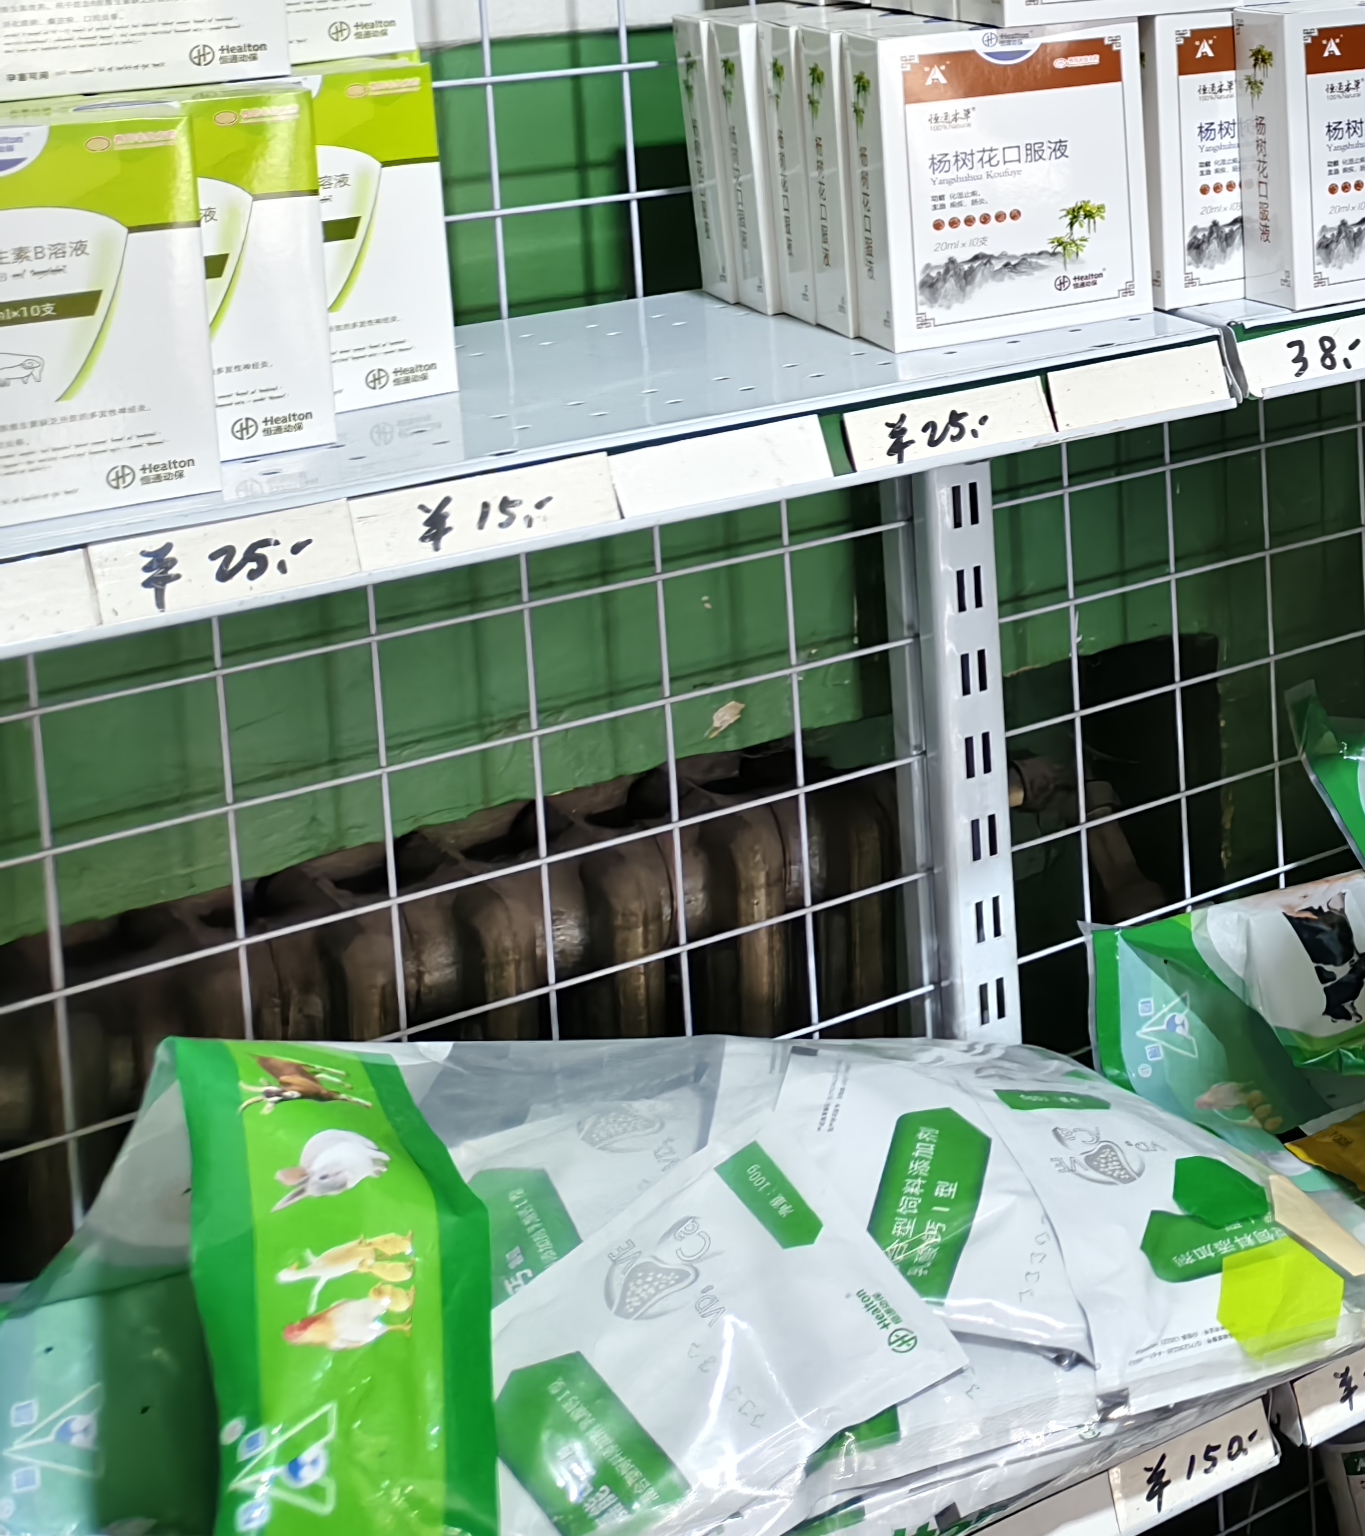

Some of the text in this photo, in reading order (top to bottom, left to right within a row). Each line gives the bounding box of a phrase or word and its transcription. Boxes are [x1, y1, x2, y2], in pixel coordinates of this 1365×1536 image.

[354, 19, 396, 30] Healton
[218, 43, 267, 55] Healton
[929, 139, 1069, 176] 杨树花口服液
[986, 169, 1022, 180] Koufuye
[1254, 115, 1271, 244] 杨树花口服液
[1073, 272, 1103, 282] Healton
[392, 362, 437, 377] Healton
[262, 410, 313, 426] Healton
[263, 422, 303, 437] 恒通动保
[140, 457, 195, 473] Healton
[854, 1287, 900, 1333] Healton
